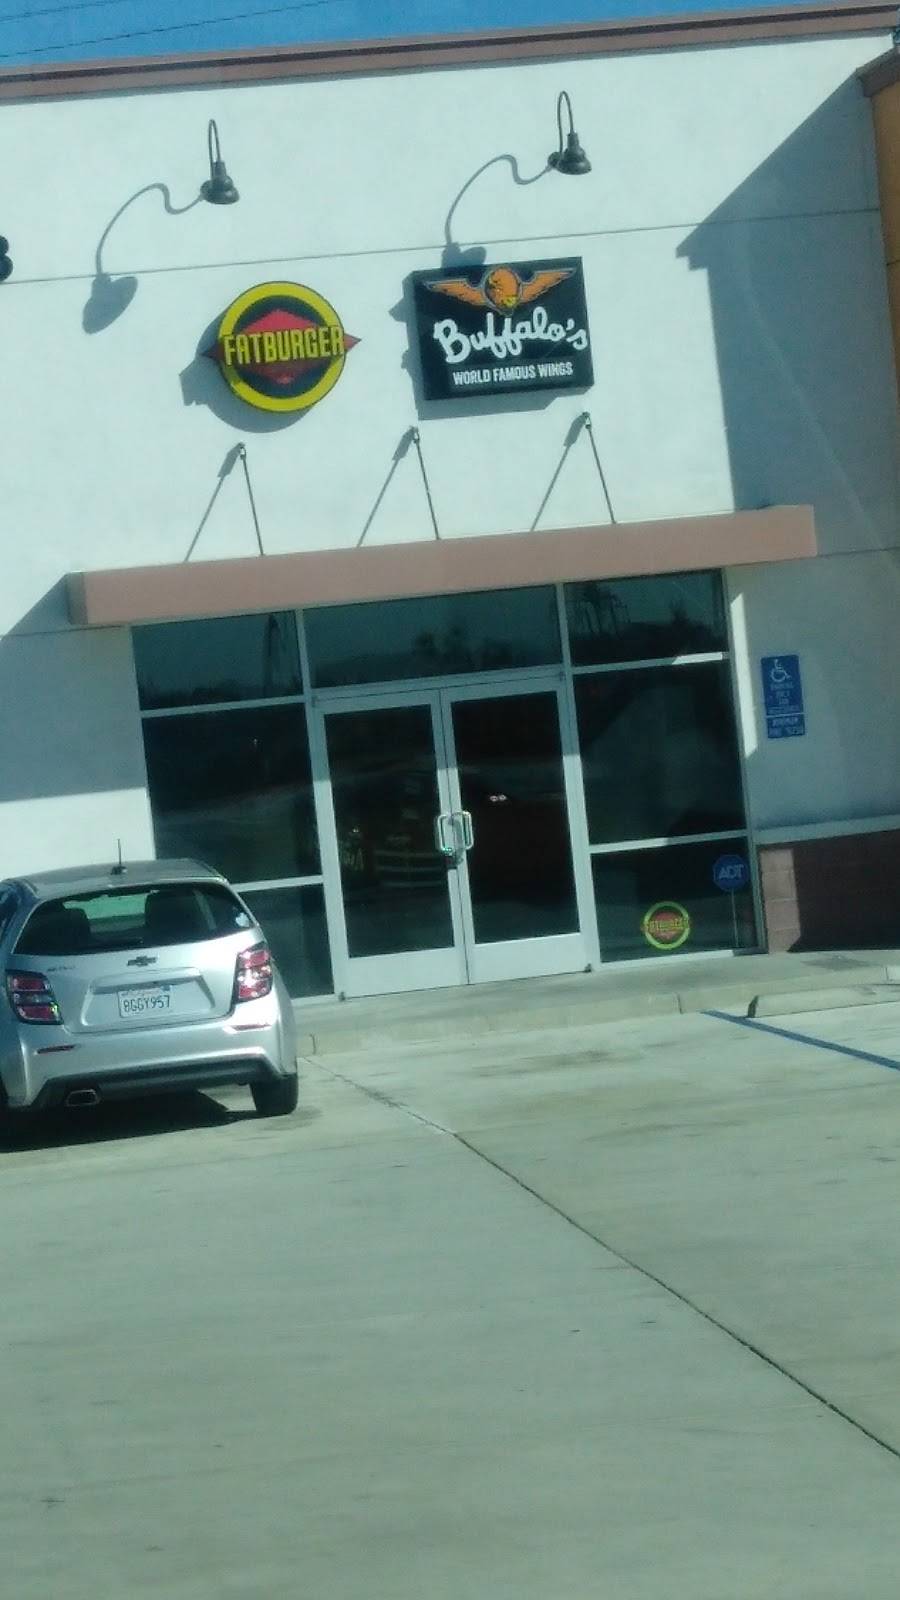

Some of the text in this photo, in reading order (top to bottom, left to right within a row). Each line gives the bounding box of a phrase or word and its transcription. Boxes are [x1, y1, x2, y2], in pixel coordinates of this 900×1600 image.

[224, 326, 345, 366] FATBURGER
[433, 306, 588, 363] Buffalo's
[453, 361, 573, 385] WORLD FAMOUS WINGS
[719, 864, 744, 879] ADT
[123, 994, 170, 1013] 8GGY957
